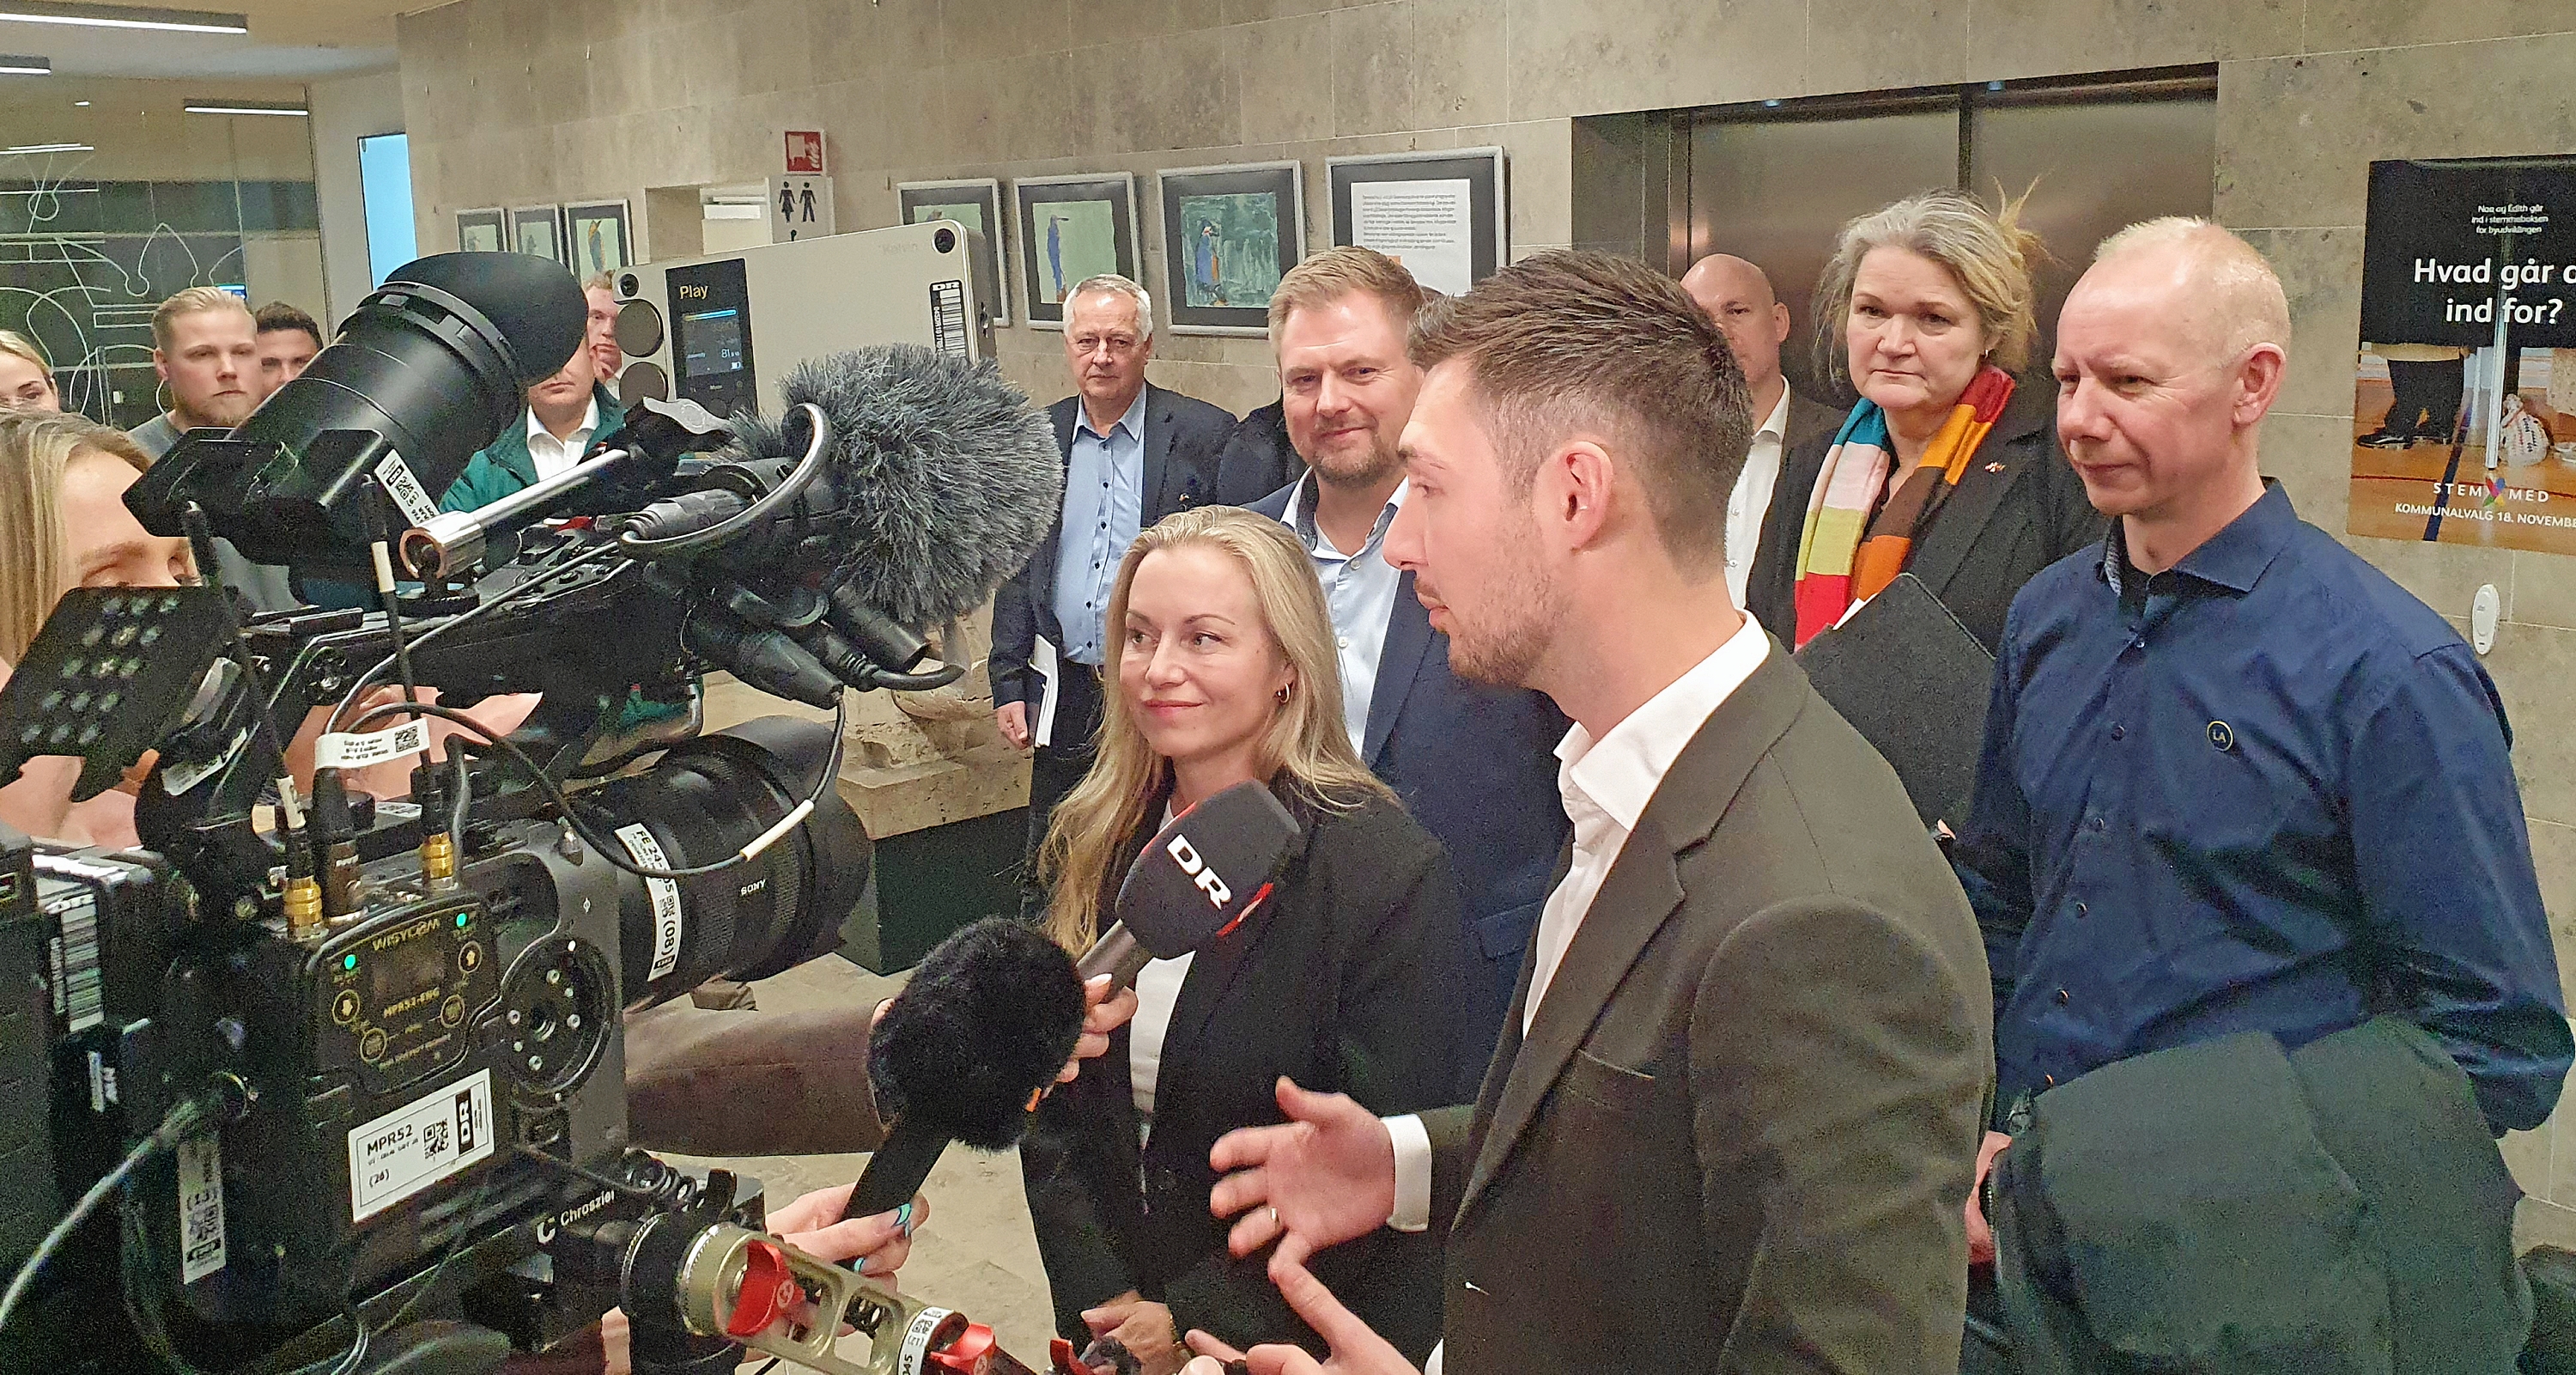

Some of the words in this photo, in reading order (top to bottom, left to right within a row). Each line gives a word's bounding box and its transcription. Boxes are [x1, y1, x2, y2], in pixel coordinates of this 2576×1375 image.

[2495, 205, 2506, 215] og
[2476, 225, 2487, 234] for
[932, 281, 960, 291] DR
[2414, 258, 2491, 283] Hvad
[2500, 258, 2555, 290] går
[679, 284, 708, 300] Play
[2446, 297, 2493, 322] ind
[2502, 297, 2563, 325] for?
[2433, 482, 2482, 497] STEM
[2508, 489, 2549, 503] MED
[2395, 502, 2494, 521] KOMMUNALVALG
[2497, 511, 2514, 523] 18.
[2212, 729, 2227, 743] LA
[636, 830, 652, 845] FE
[648, 846, 674, 893] 24-05
[1166, 833, 1231, 910] DR
[740, 879, 766, 897] SONY
[373, 918, 440, 951] WISYCOM
[662, 920, 676, 956] (08)
[459, 1099, 471, 1145] DR
[367, 1123, 414, 1157] MPR52
